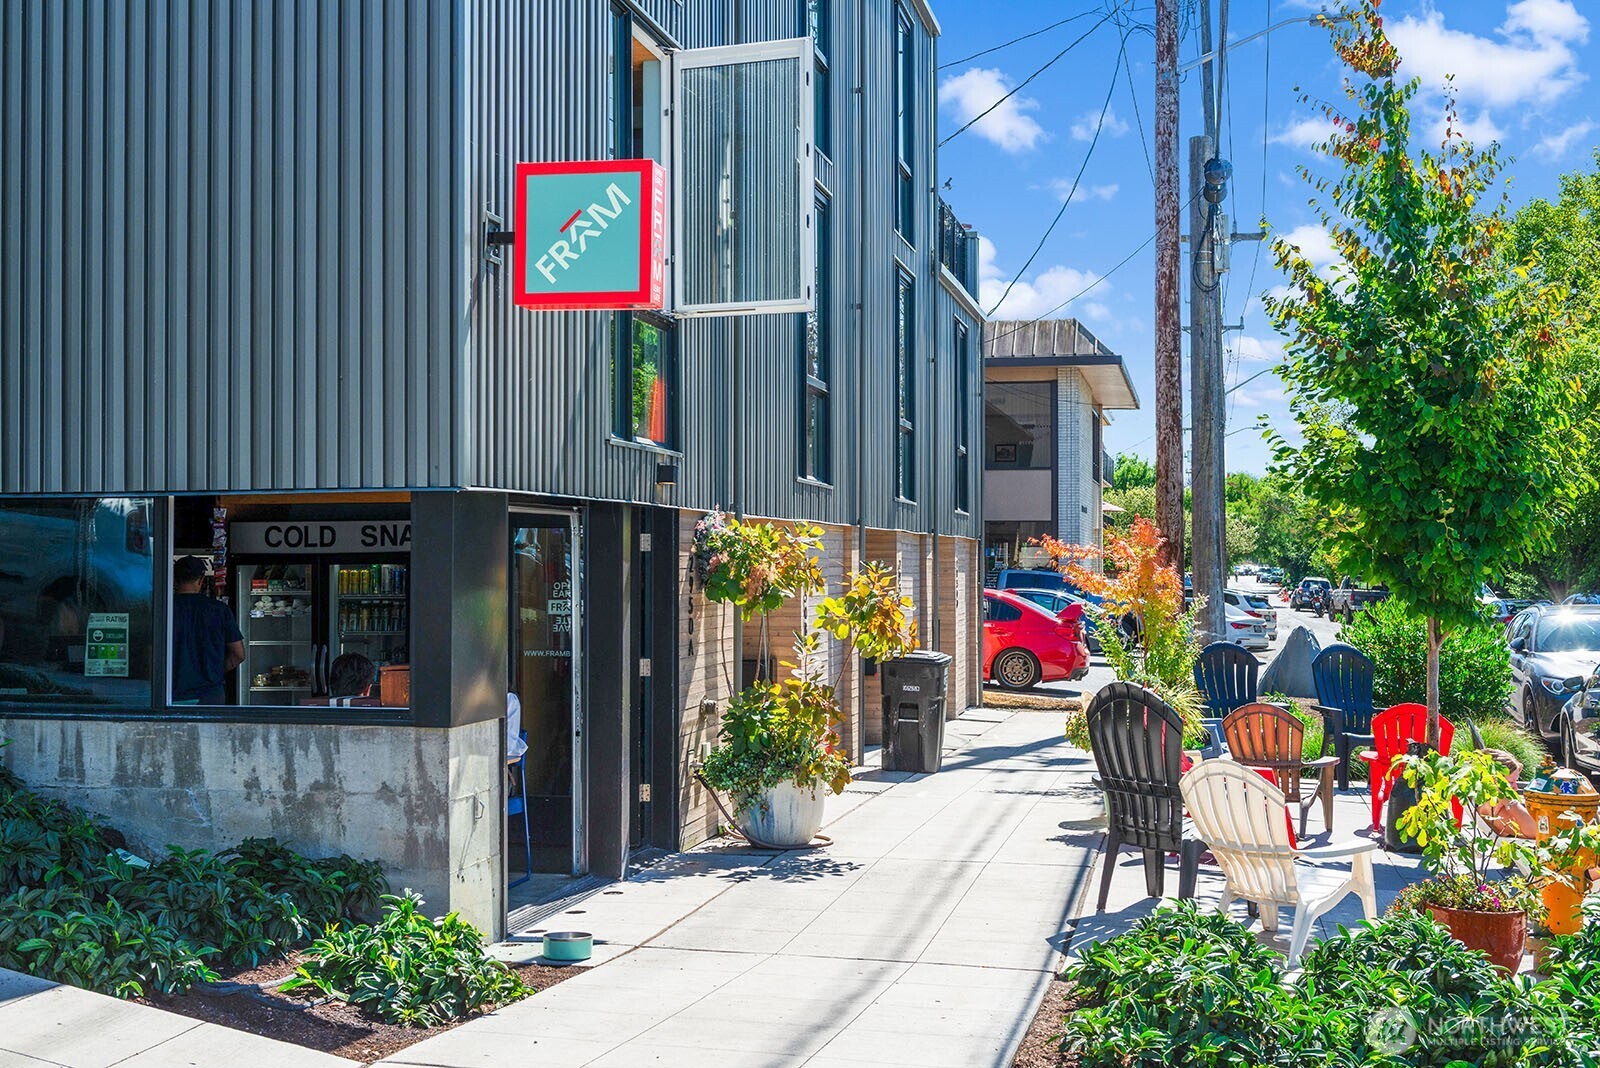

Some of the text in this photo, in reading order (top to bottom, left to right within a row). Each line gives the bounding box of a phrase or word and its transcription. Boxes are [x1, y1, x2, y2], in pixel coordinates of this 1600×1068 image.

[264, 524, 412, 548] COLD SNA
[553, 582, 571, 590] OP
[105, 615, 128, 623] RATING
